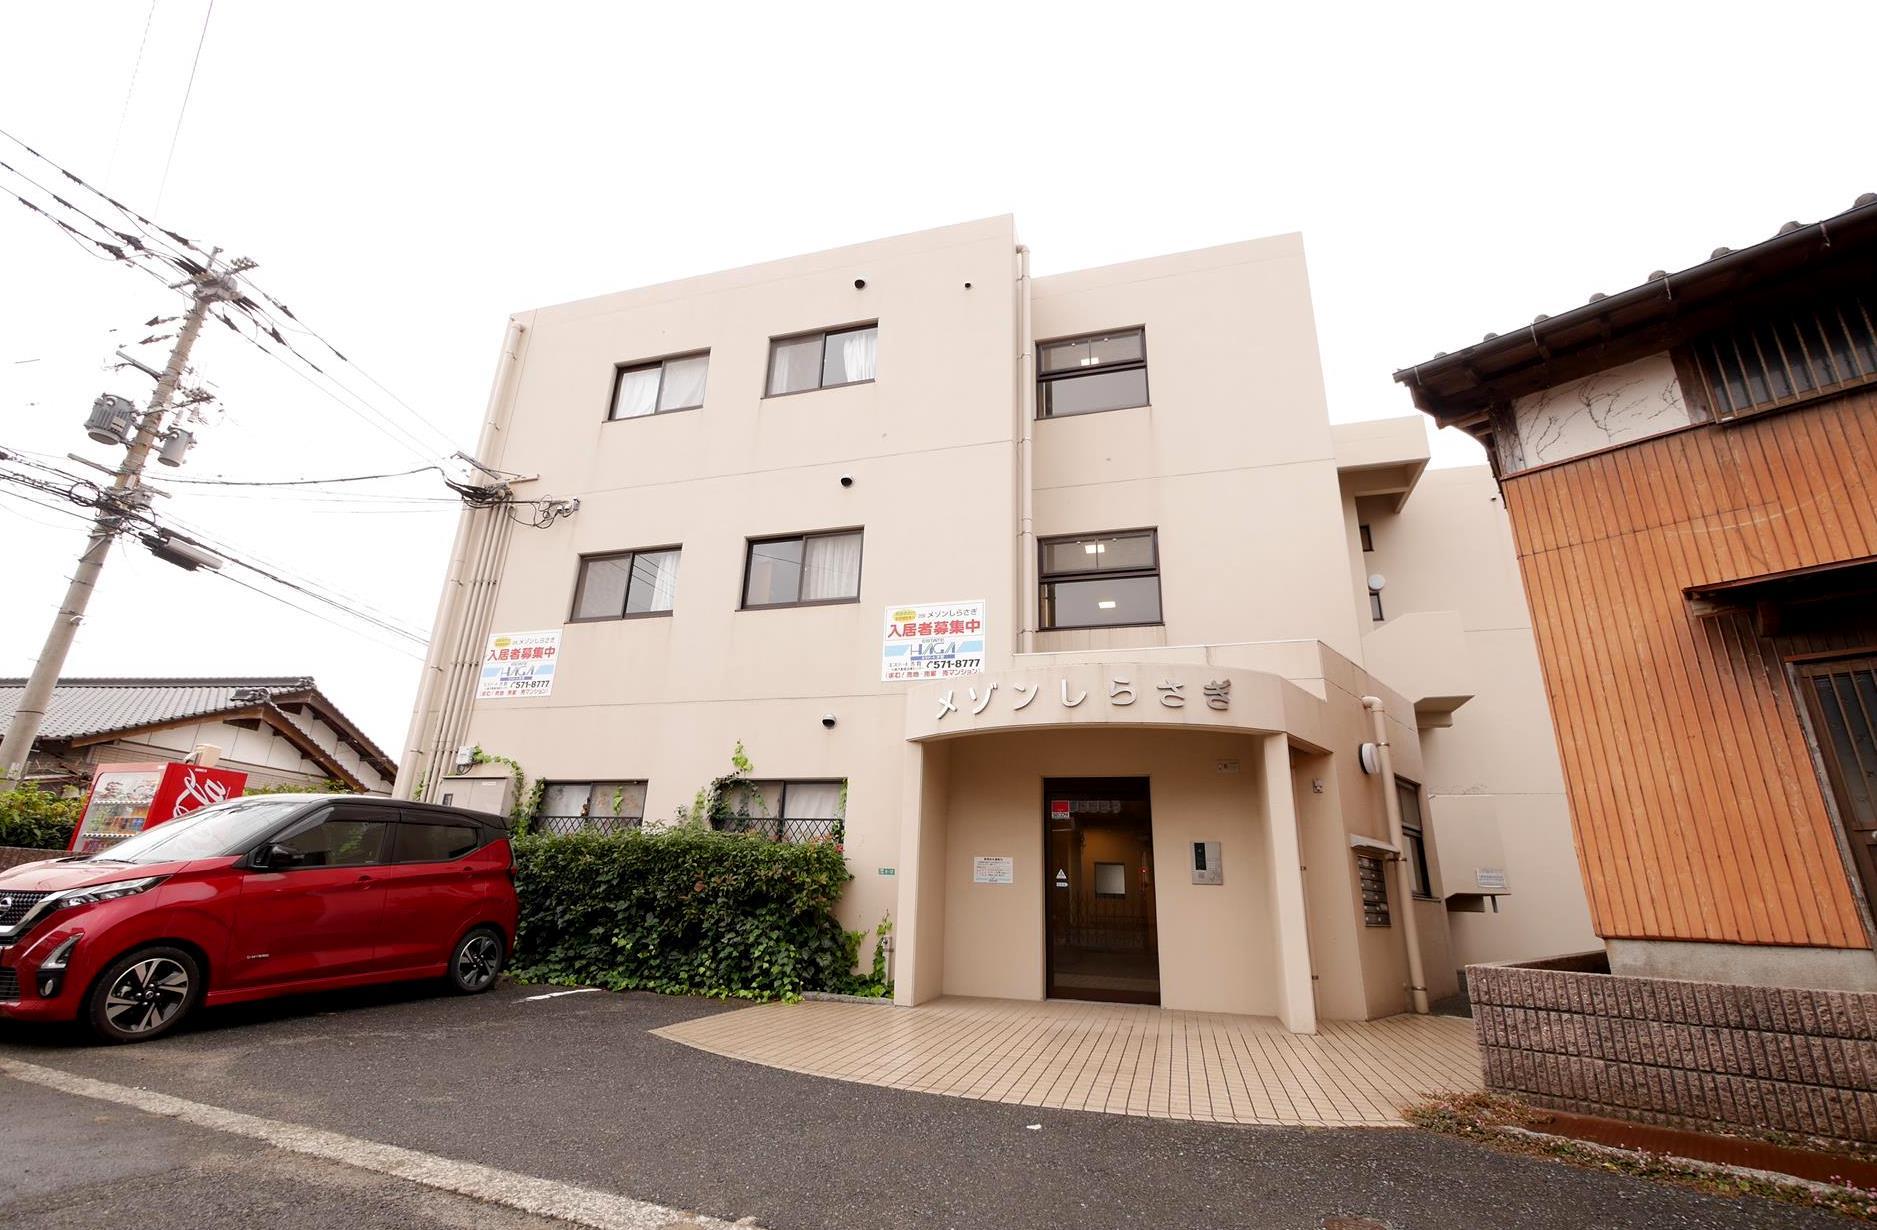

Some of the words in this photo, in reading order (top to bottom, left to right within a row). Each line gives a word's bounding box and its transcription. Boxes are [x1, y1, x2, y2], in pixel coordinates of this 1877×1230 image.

[887, 619, 981, 638] 入居者募集中
[488, 646, 555, 661] 入居者募集中
[933, 659, 981, 669] 571-8777
[515, 680, 550, 688] 571-8777
[936, 679, 1232, 720] メゾンしらさぎ
